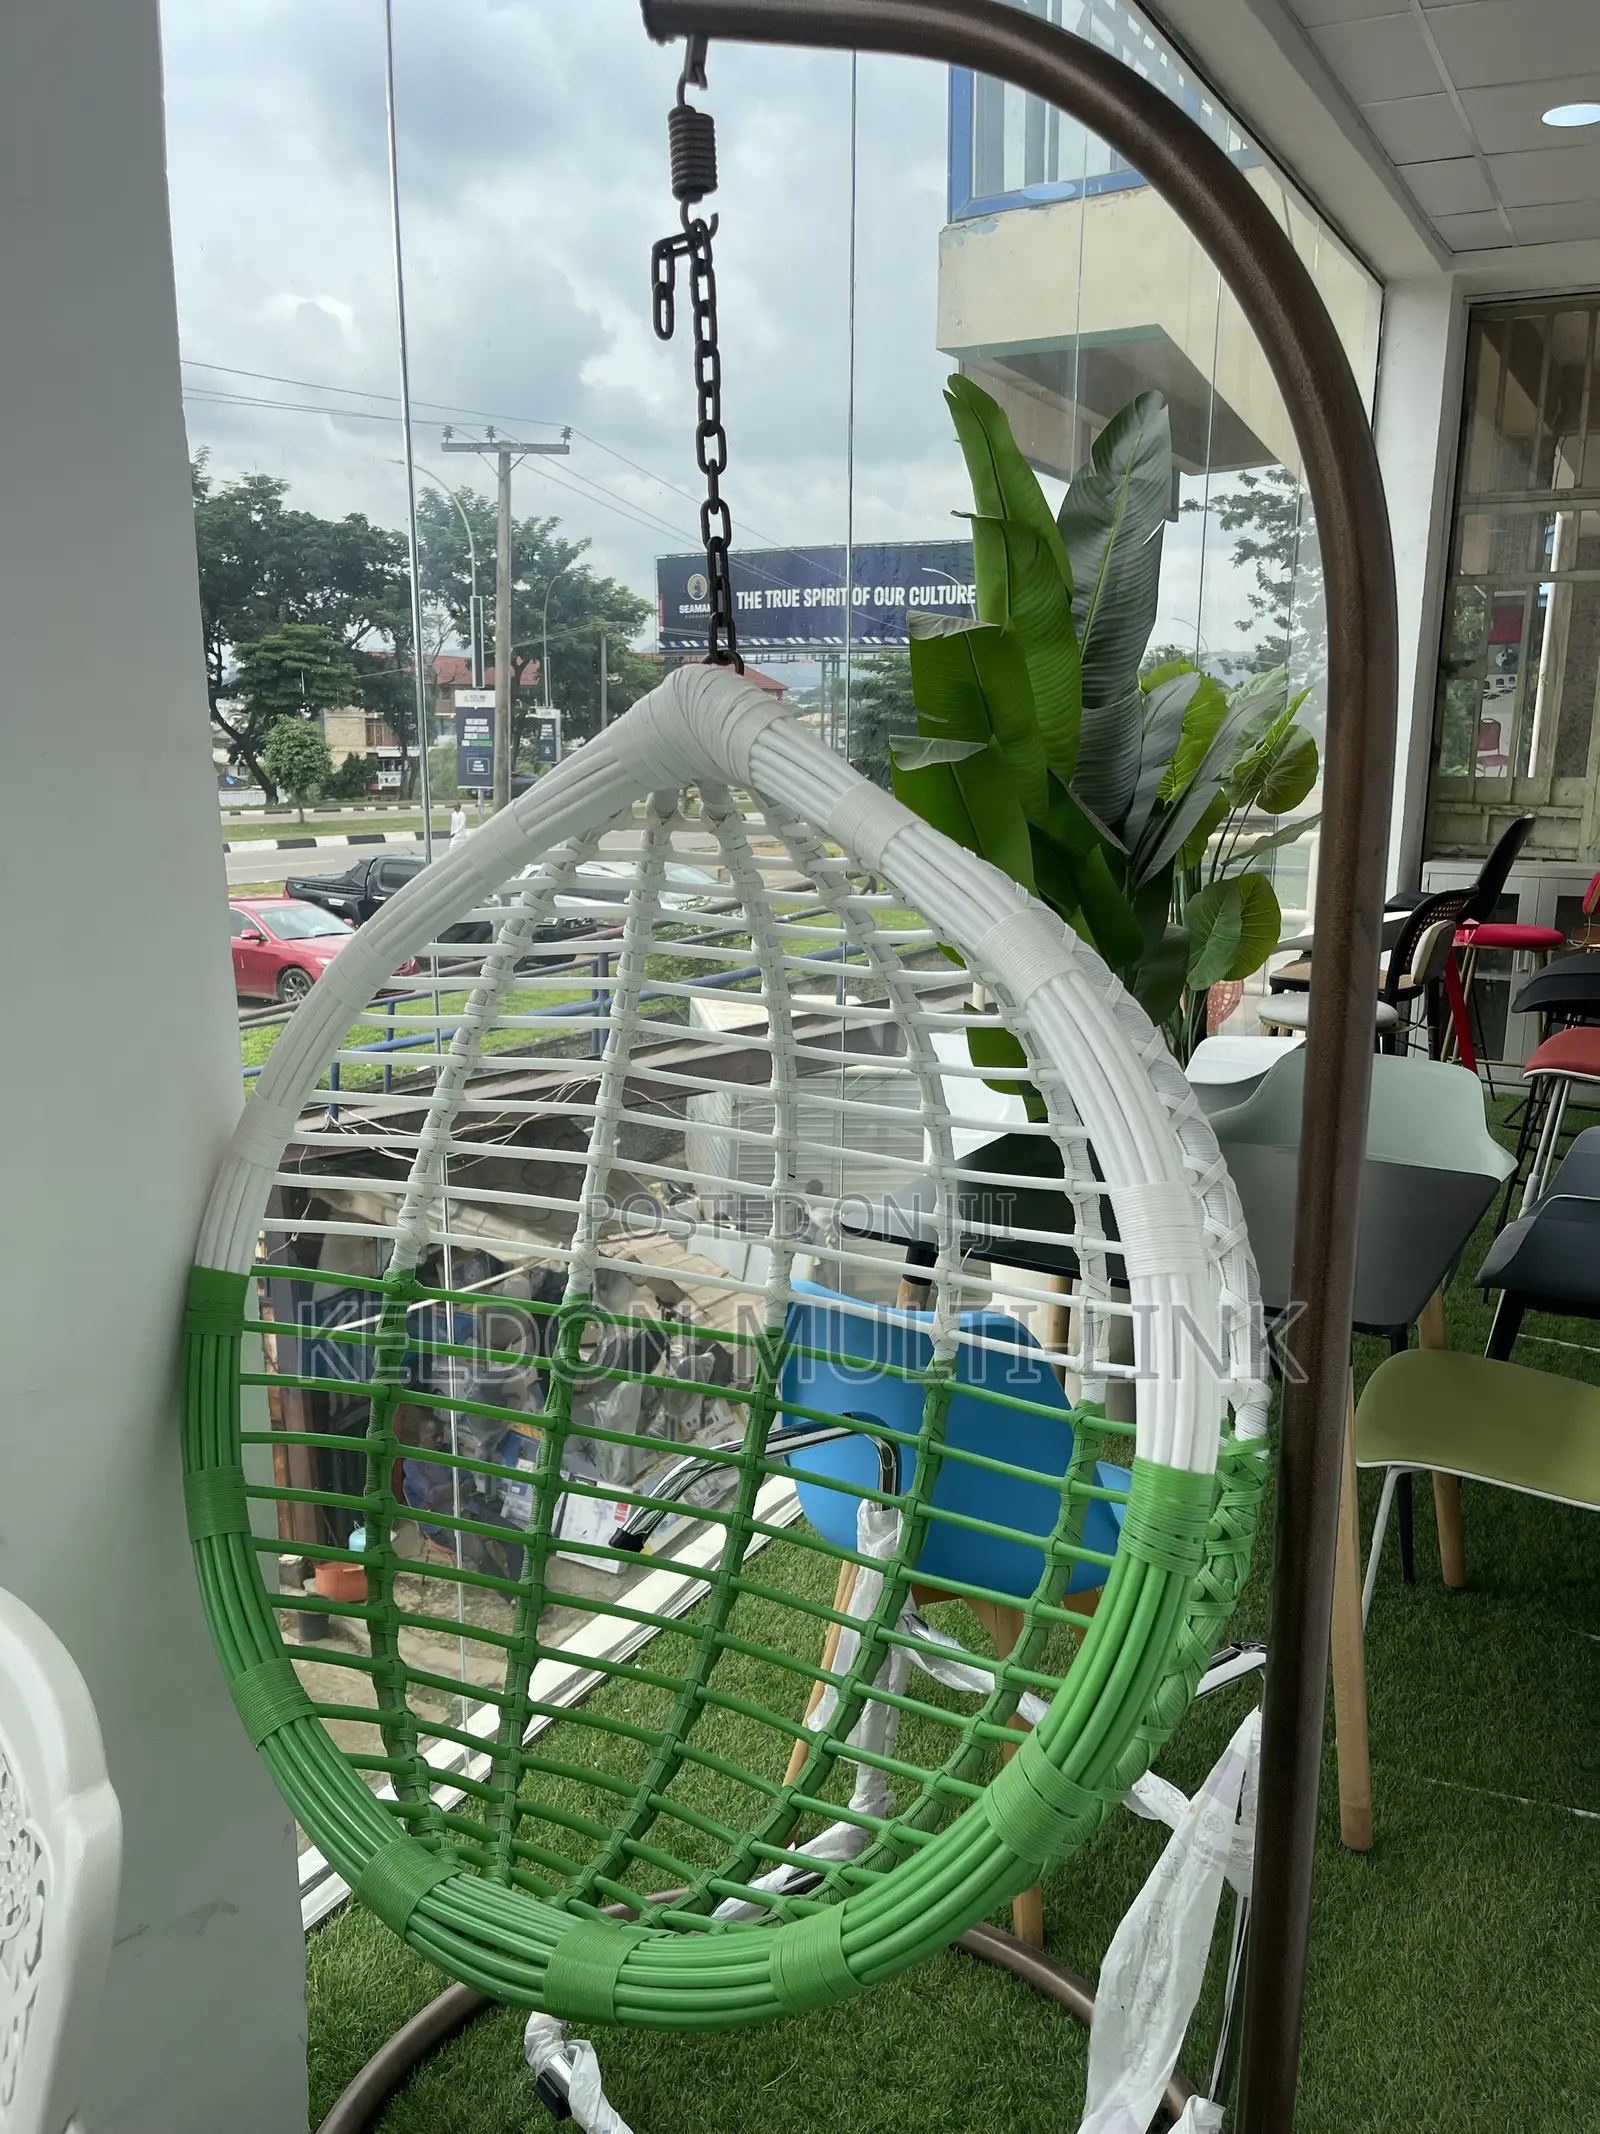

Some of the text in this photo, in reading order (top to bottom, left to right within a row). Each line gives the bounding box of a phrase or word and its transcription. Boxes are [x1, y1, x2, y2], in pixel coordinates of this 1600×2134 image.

[736, 584, 977, 610] THE TRUE SPIRIT OF OUR CULTURE
